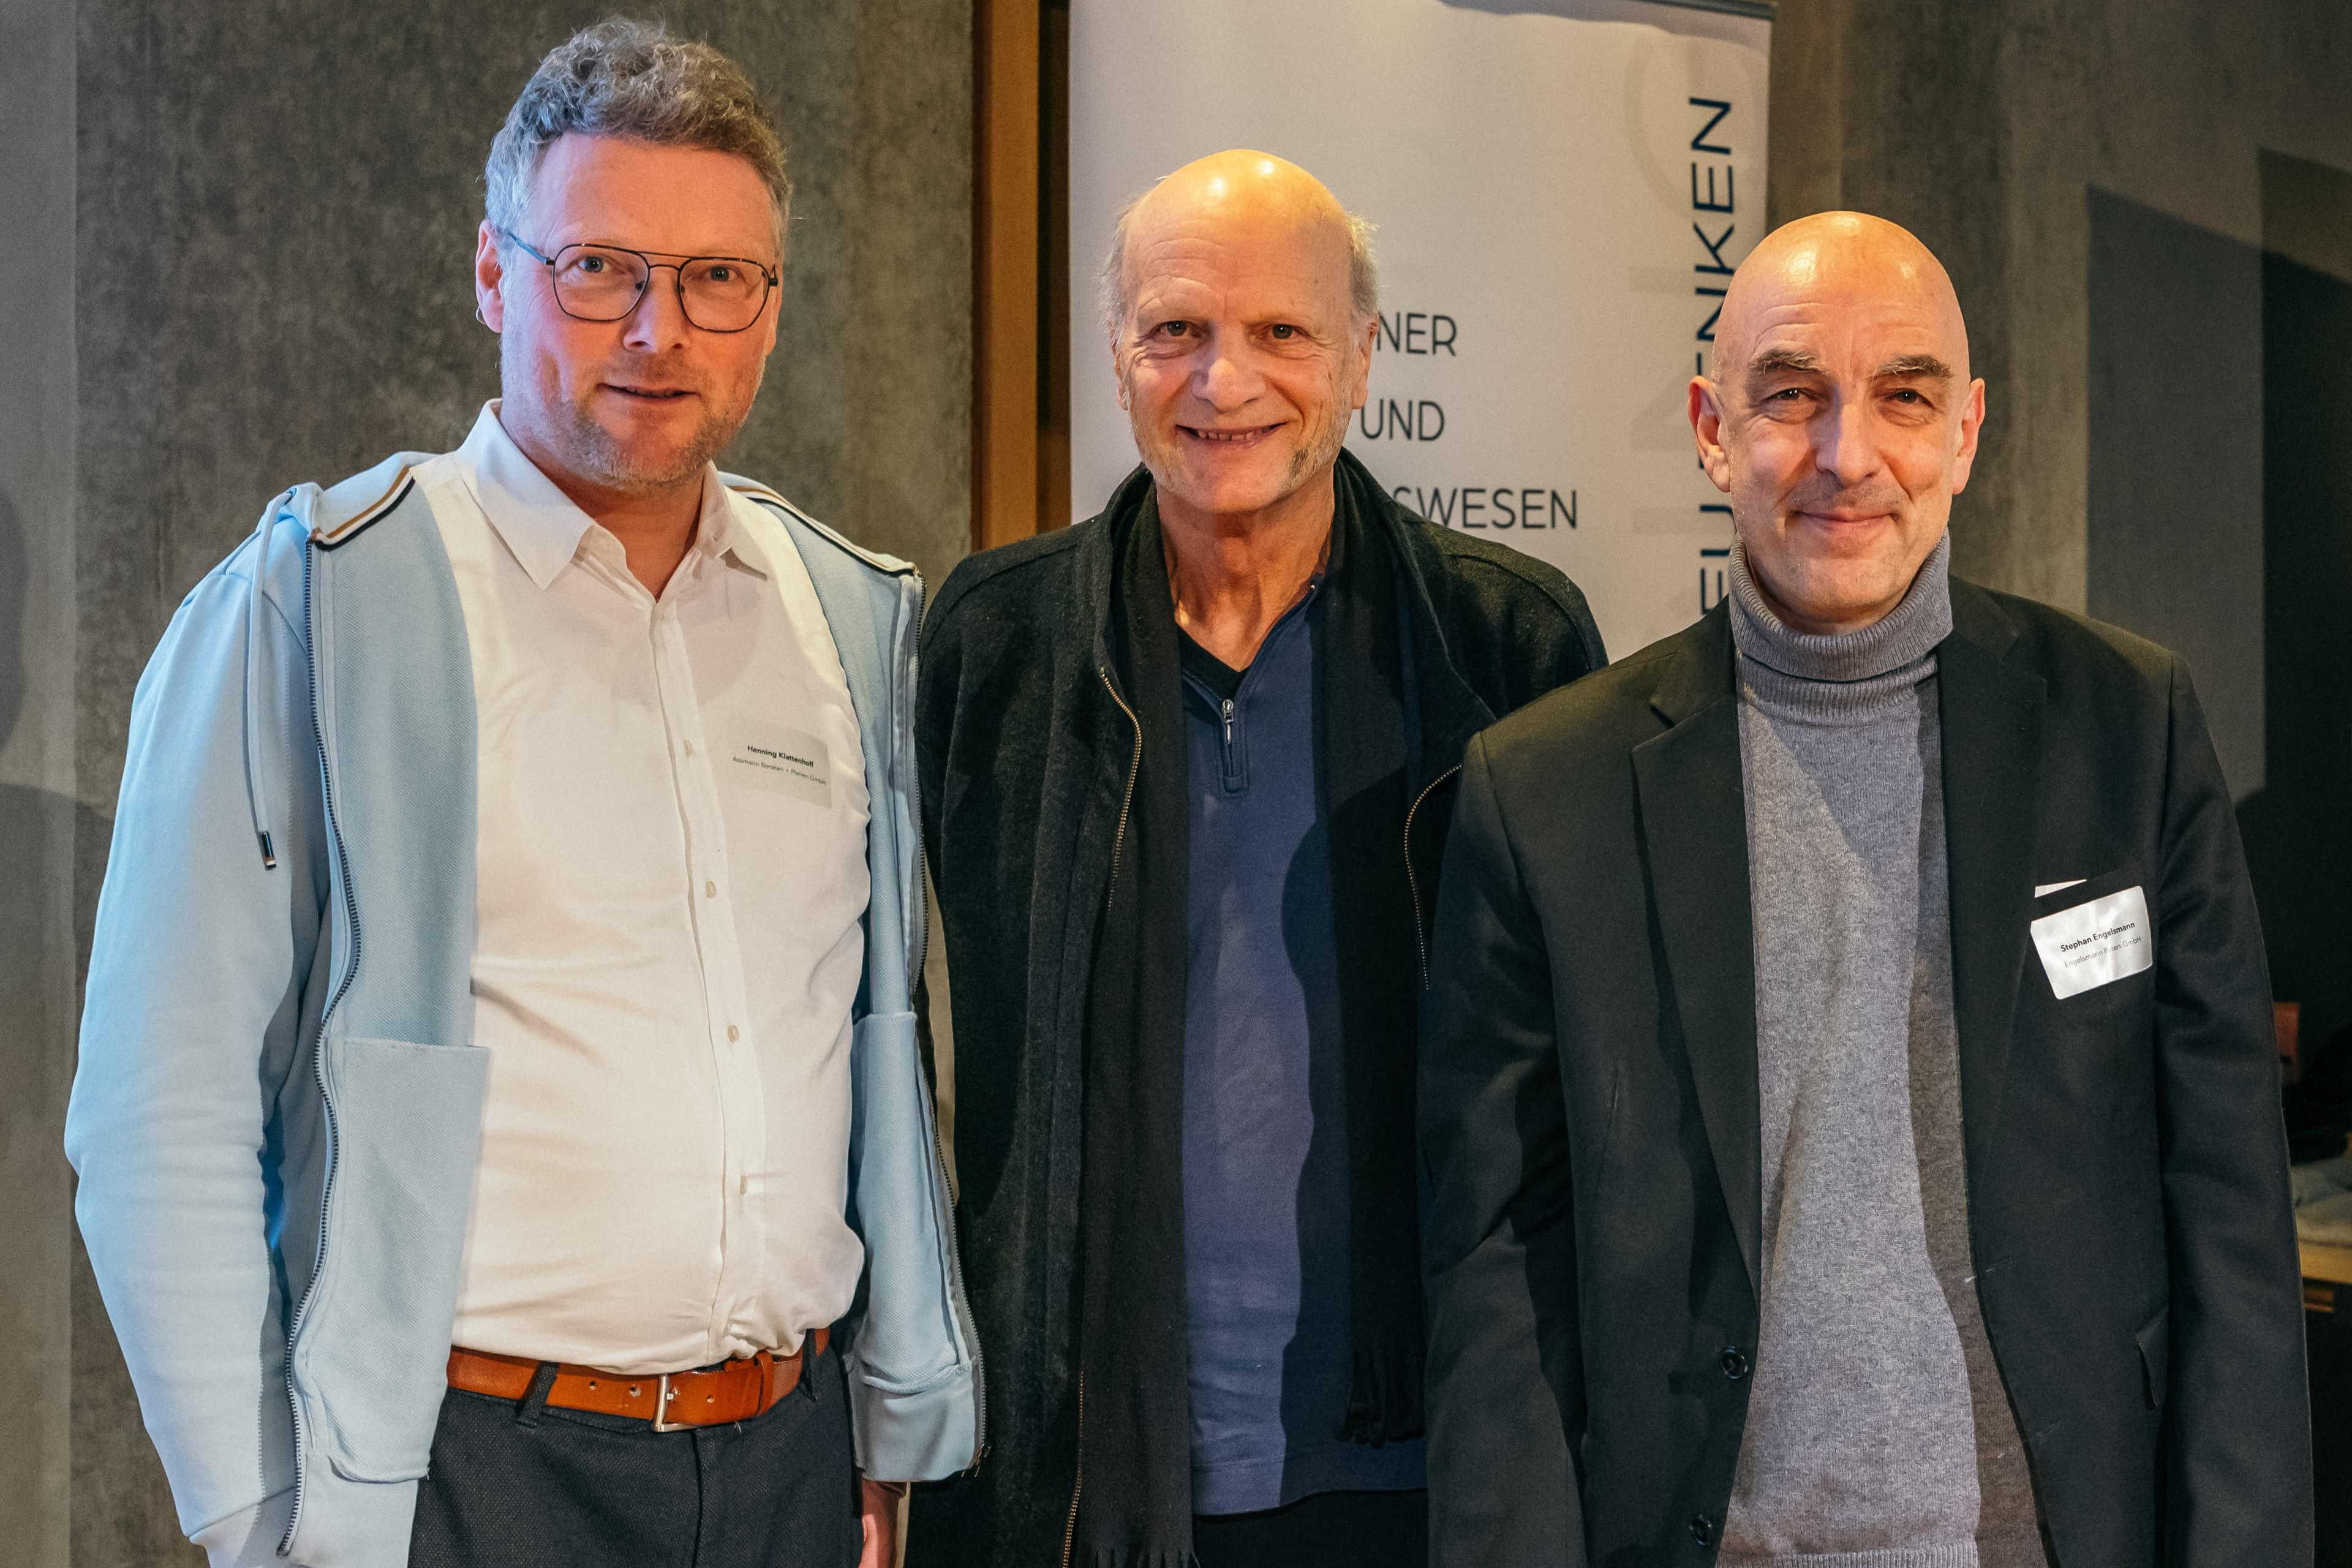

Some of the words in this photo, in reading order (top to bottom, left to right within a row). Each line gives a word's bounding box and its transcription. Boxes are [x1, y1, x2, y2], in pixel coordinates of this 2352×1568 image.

[1689, 96, 1735, 469] NKEN
[1376, 312, 1457, 356] NER
[1360, 398, 1445, 442] UND
[733, 756, 760, 767] Assmann
[761, 761, 784, 772] Beraten
[791, 769, 809, 779] Planen
[810, 774, 826, 785] GmbH
[747, 745, 777, 759] Henning
[778, 752, 814, 768] Klattenhoff
[2060, 936, 2092, 952] Stephan
[2092, 922, 2136, 941] Engelsmann
[2064, 951, 2103, 968] Engelsmann
[2103, 944, 2122, 954] Pters
[2122, 935, 2141, 947] GmbH
